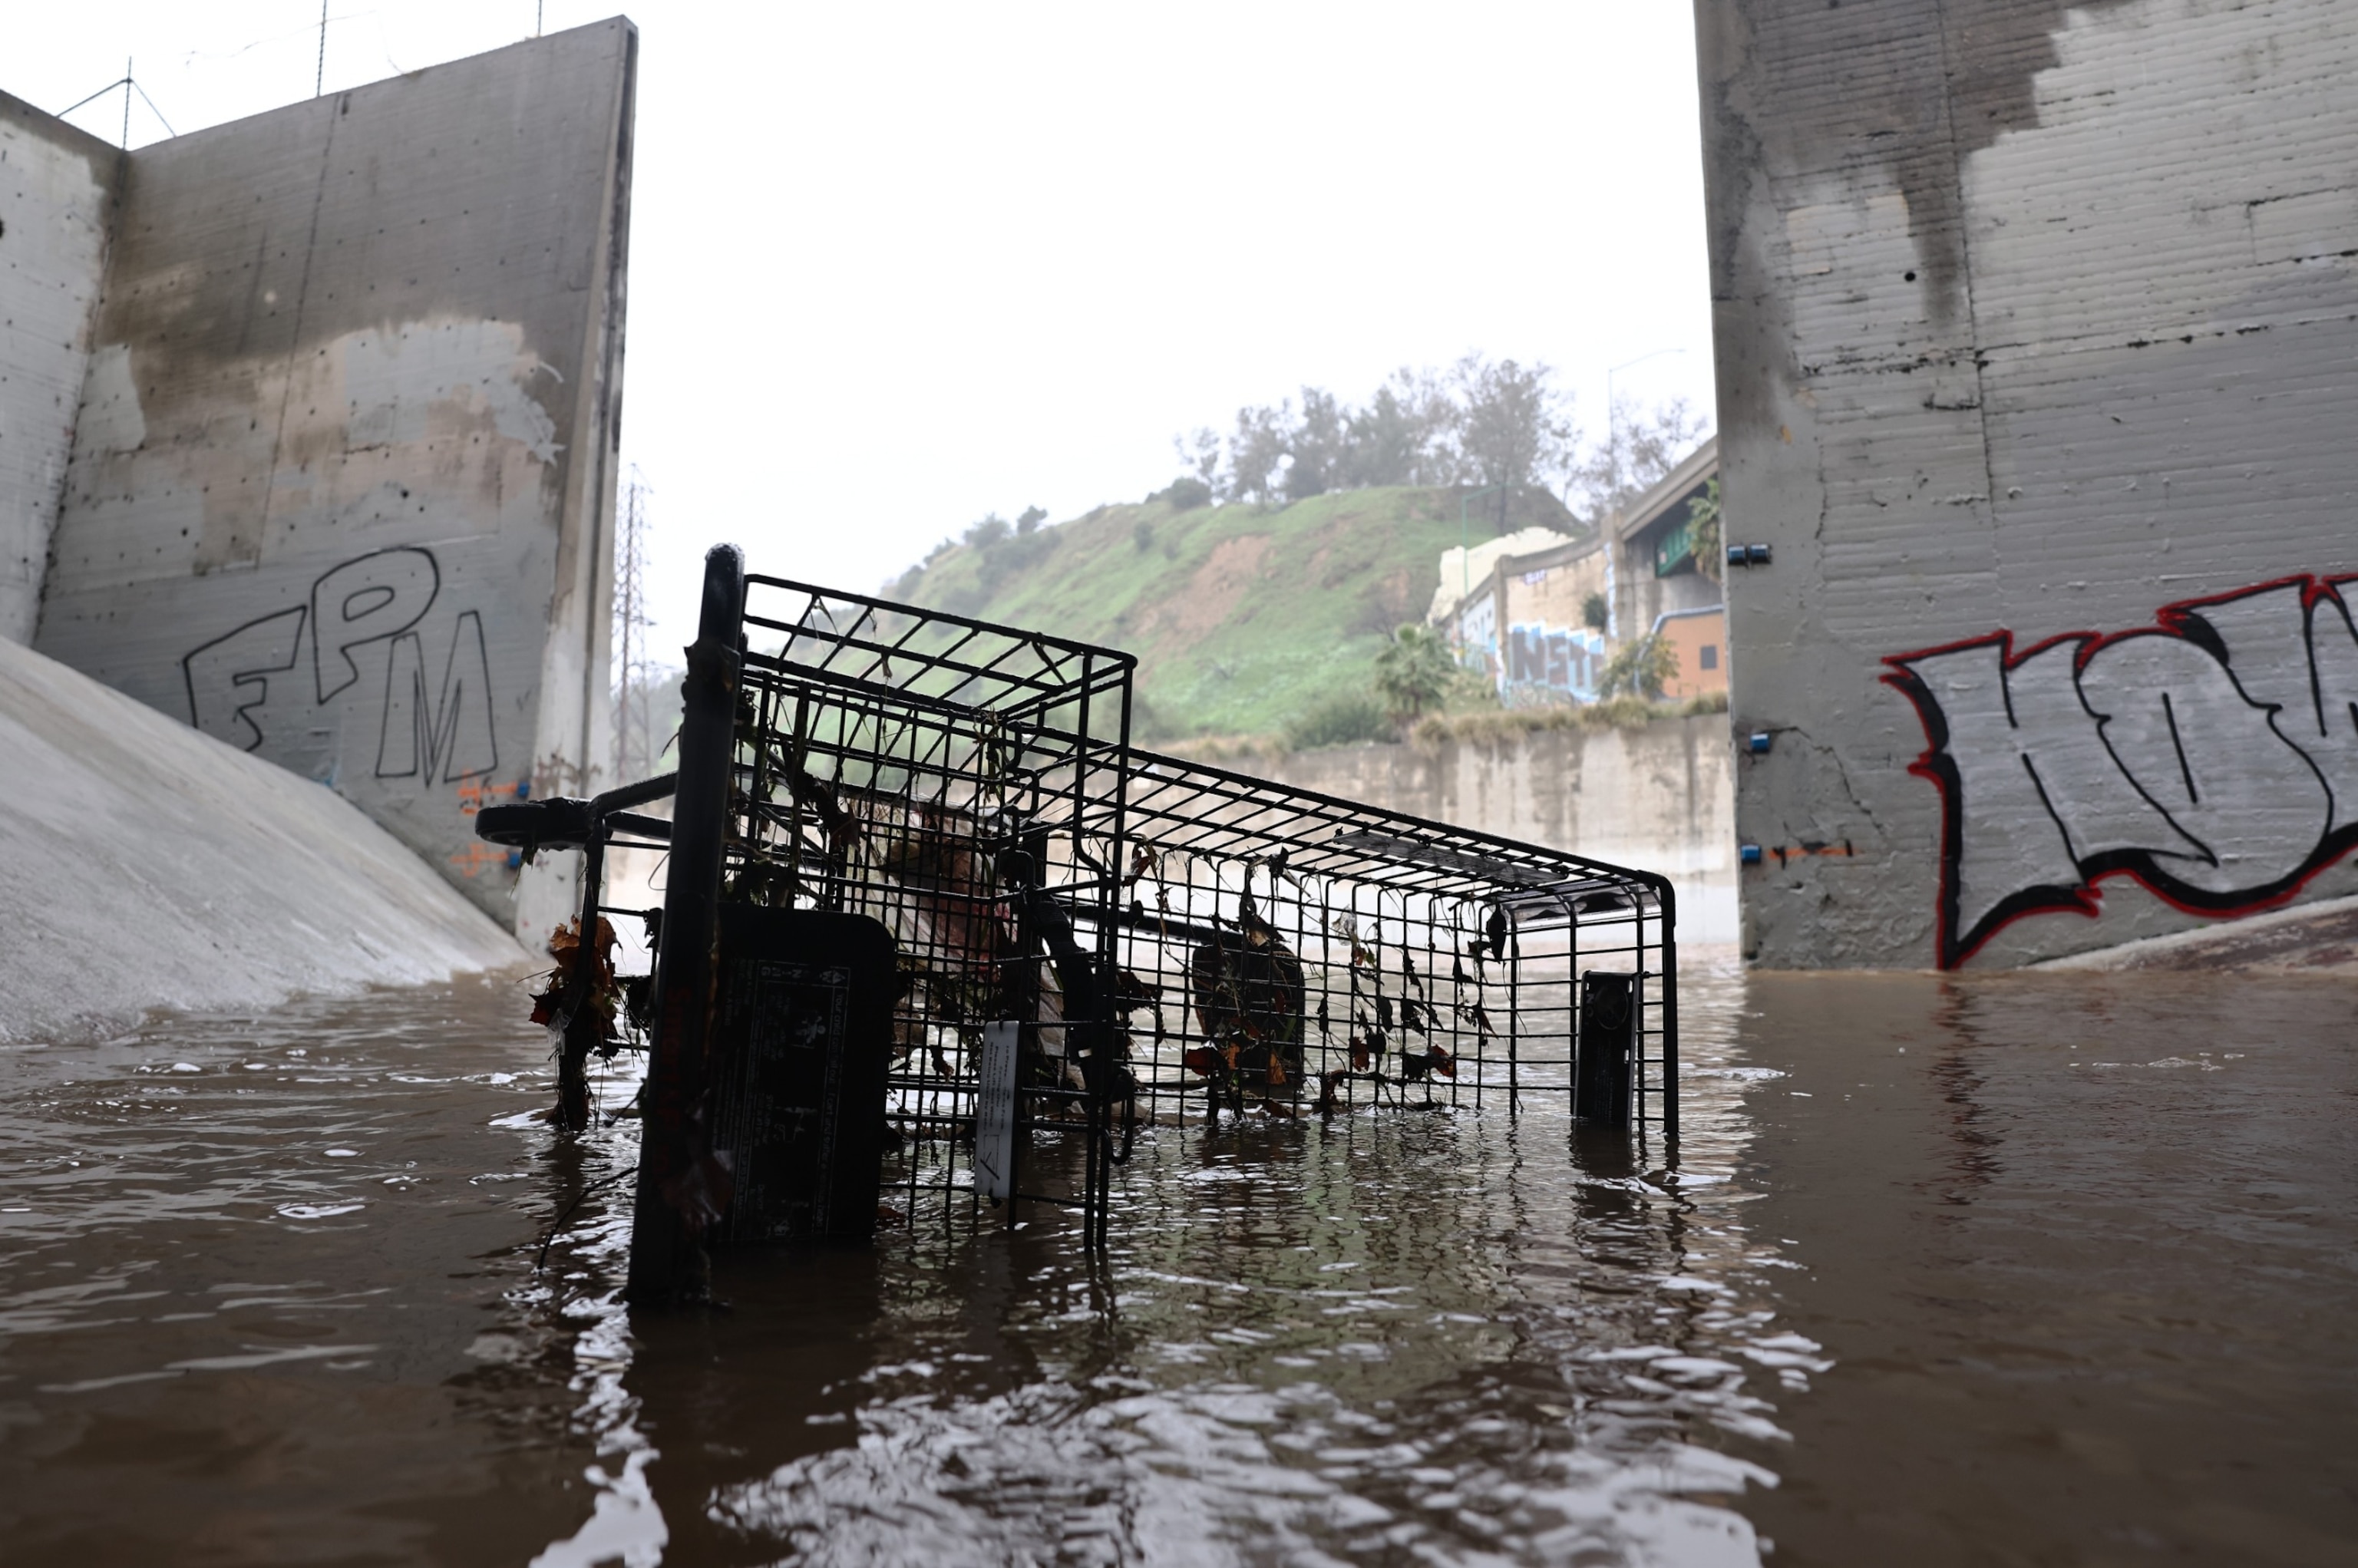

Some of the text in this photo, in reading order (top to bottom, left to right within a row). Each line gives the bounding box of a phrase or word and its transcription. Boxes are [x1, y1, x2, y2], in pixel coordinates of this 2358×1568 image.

[761, 966, 834, 982] WNING
[834, 993, 844, 1013] Your
[833, 1015, 843, 1036] child
[826, 1098, 834, 1114] cart
[824, 1117, 832, 1134] and
